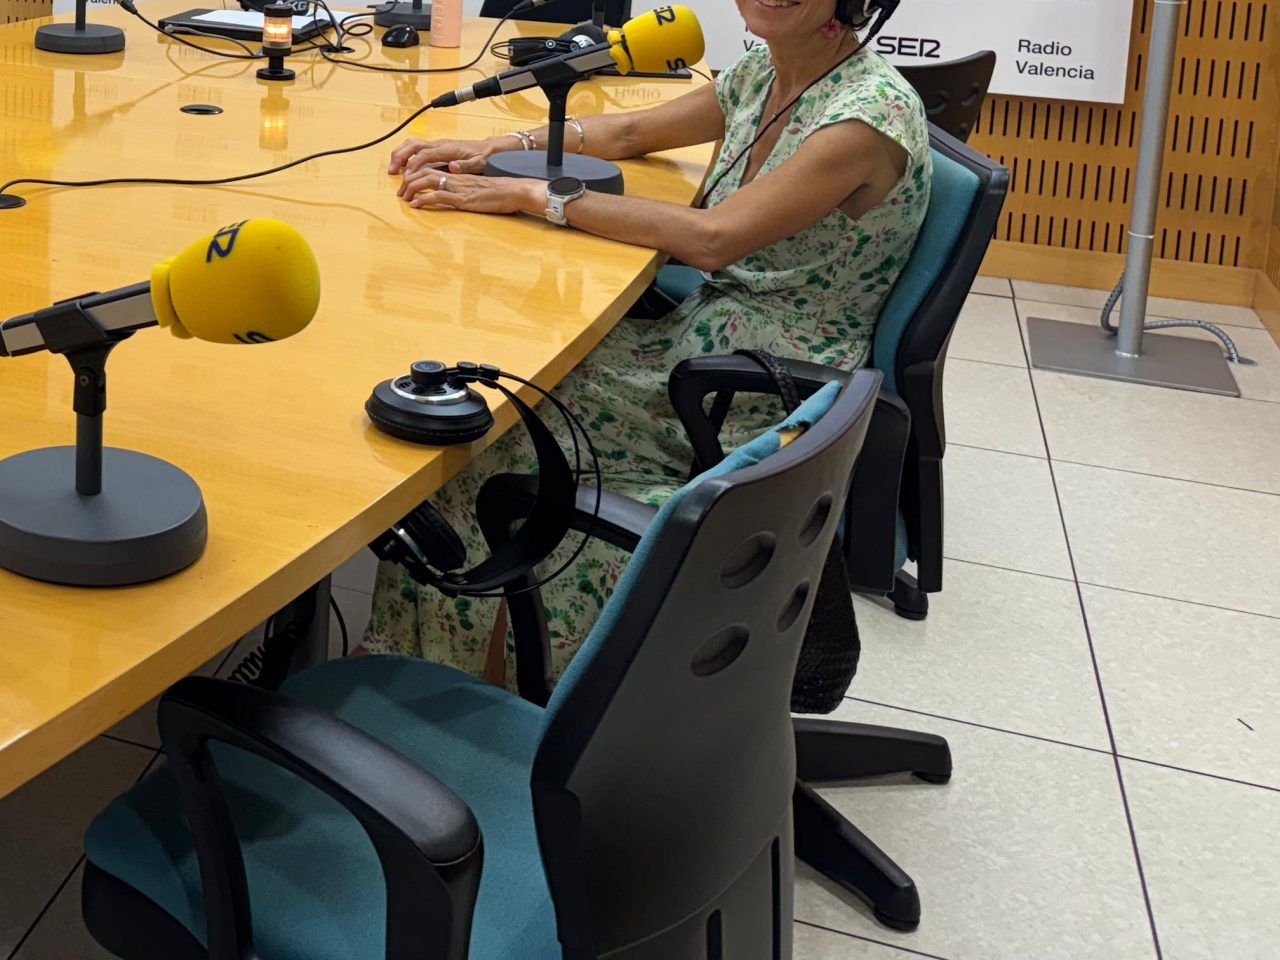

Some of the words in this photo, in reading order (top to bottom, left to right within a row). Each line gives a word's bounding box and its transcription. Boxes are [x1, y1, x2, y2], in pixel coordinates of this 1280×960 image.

[876, 35, 941, 58] SER
[1018, 39, 1072, 56] Radio
[1016, 60, 1094, 80] Valencia
